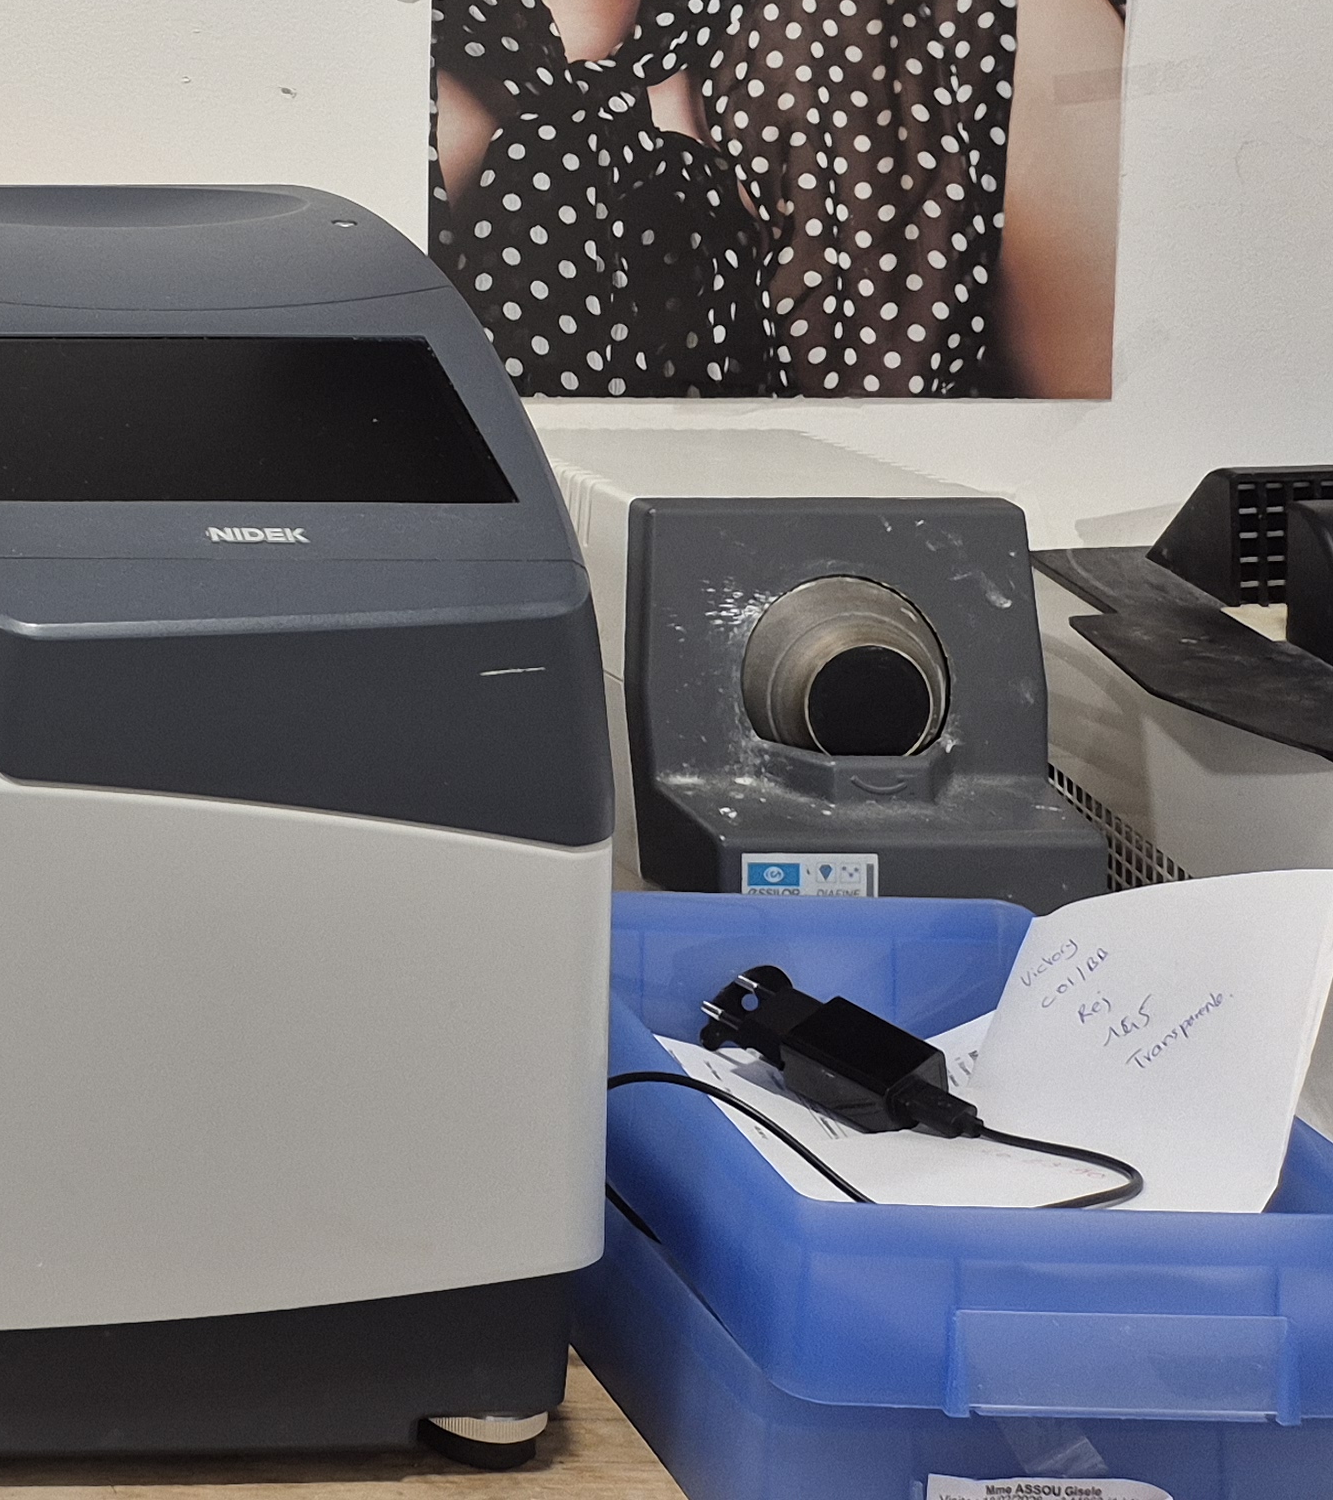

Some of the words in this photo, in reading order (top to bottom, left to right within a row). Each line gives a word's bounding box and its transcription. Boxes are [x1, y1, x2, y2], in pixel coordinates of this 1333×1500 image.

[207, 526, 311, 544] NIDEK
[985, 1484, 1013, 1496] Mme
[1015, 1483, 1062, 1497] ASSOU
[1064, 1485, 1103, 1497] Gisele
